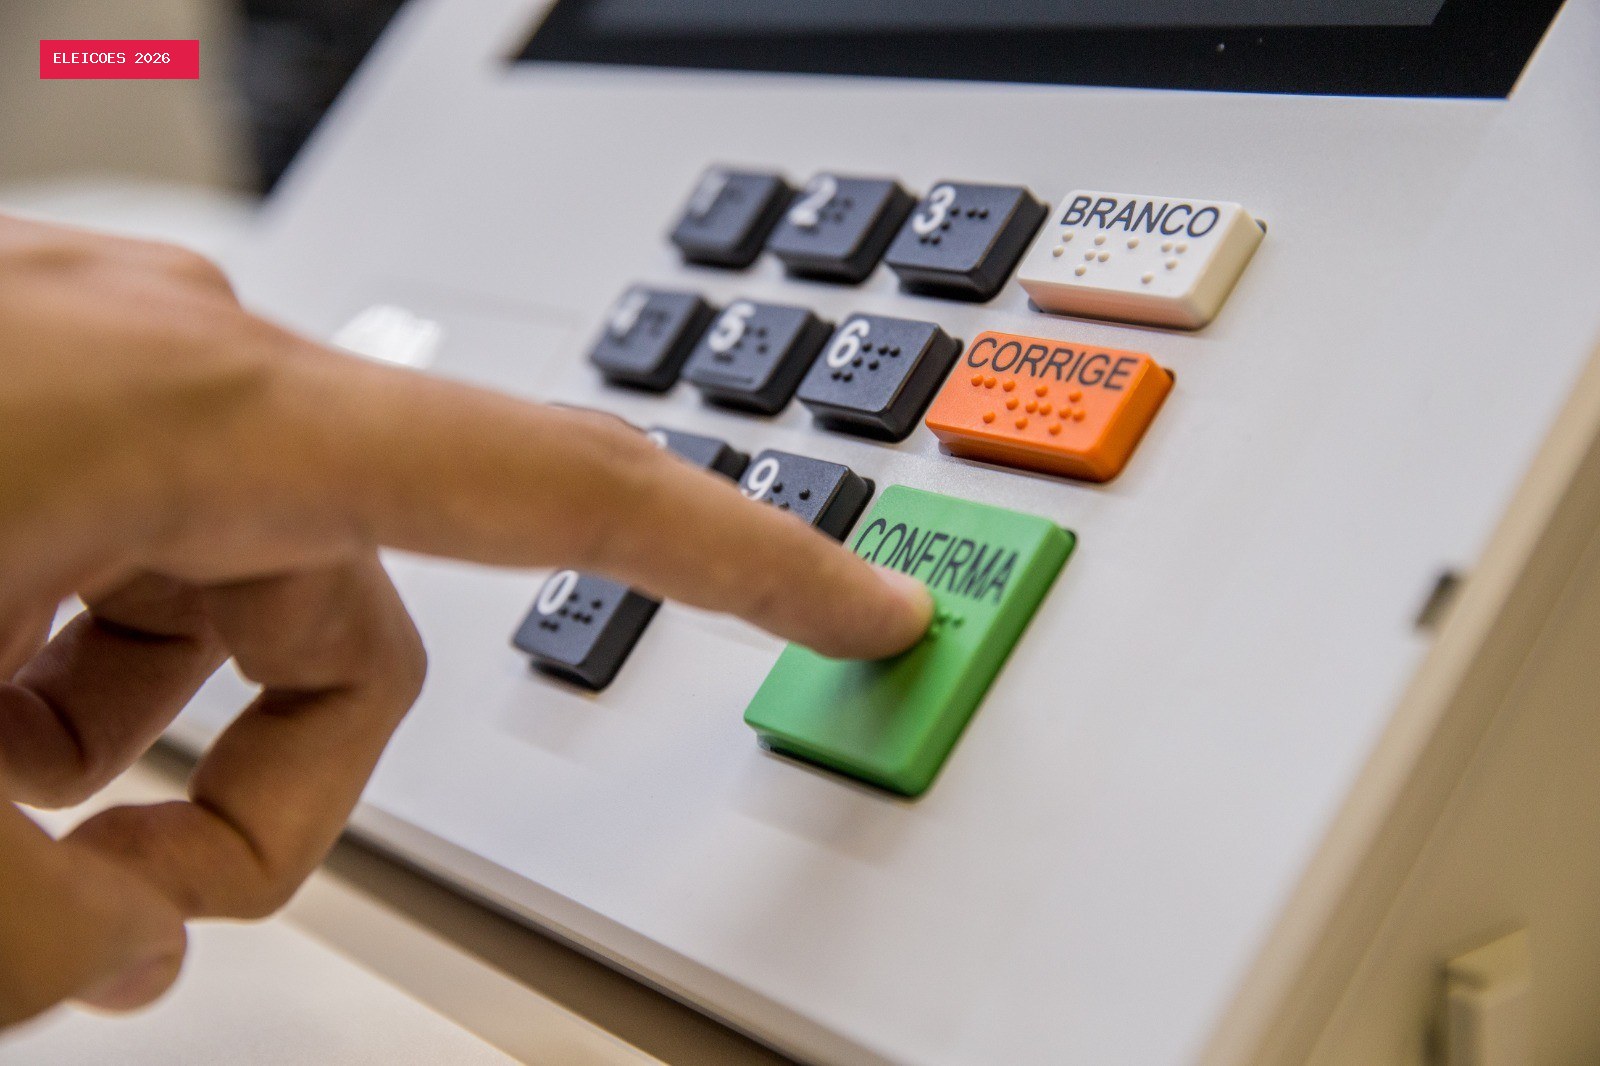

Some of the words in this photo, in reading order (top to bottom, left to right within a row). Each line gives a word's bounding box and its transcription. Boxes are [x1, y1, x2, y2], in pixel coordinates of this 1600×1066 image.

[790, 173, 838, 227] 2
[913, 185, 956, 235] 3
[1060, 195, 1221, 238] BRANCO
[708, 302, 755, 351] 5
[826, 318, 870, 369] 6
[967, 337, 1138, 391] CORRIGE
[741, 457, 780, 501] 9
[853, 518, 1018, 605] CONFIRMA
[537, 570, 579, 615] 0
